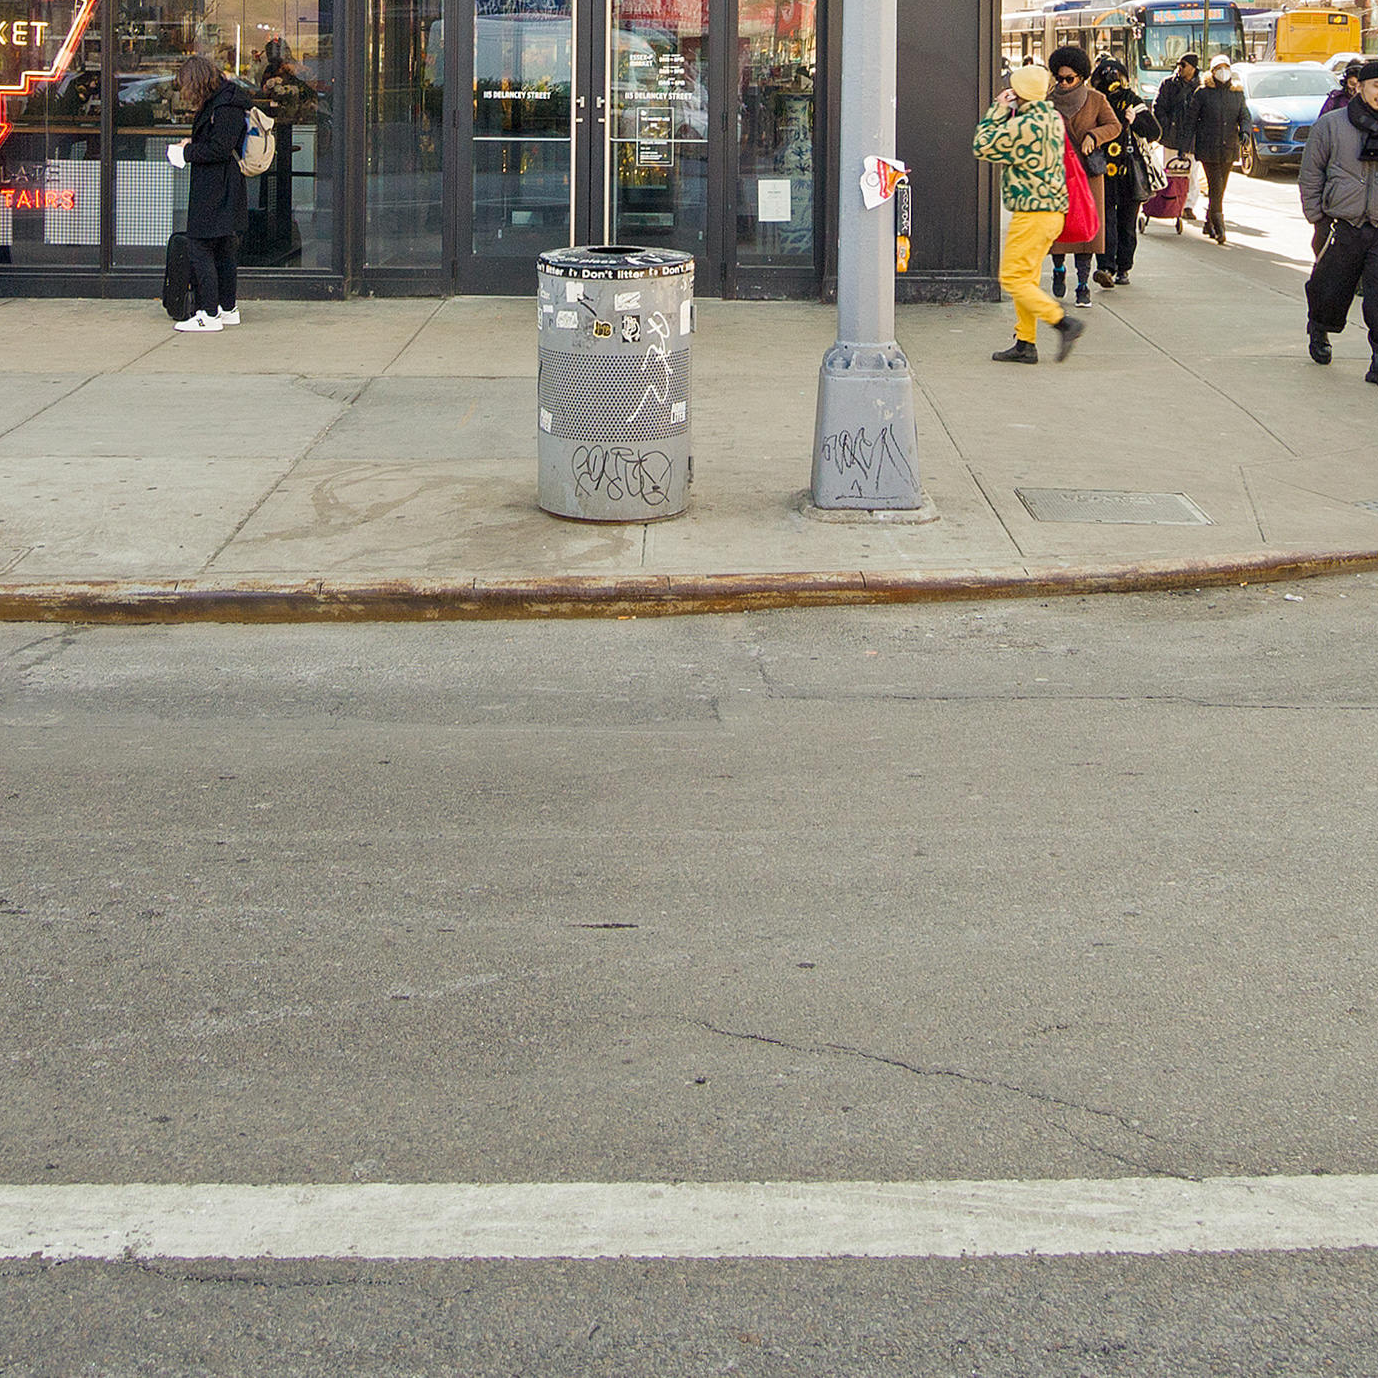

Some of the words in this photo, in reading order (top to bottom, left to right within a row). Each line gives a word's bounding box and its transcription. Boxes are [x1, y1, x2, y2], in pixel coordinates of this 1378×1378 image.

[493, 91, 526, 100] DELANCEY
[527, 91, 552, 100] STREET
[634, 92, 668, 100] DELANCEY
[668, 92, 693, 100] STREET
[582, 269, 614, 280] Don't
[617, 270, 645, 280] litter
[662, 263, 684, 276] Don't
